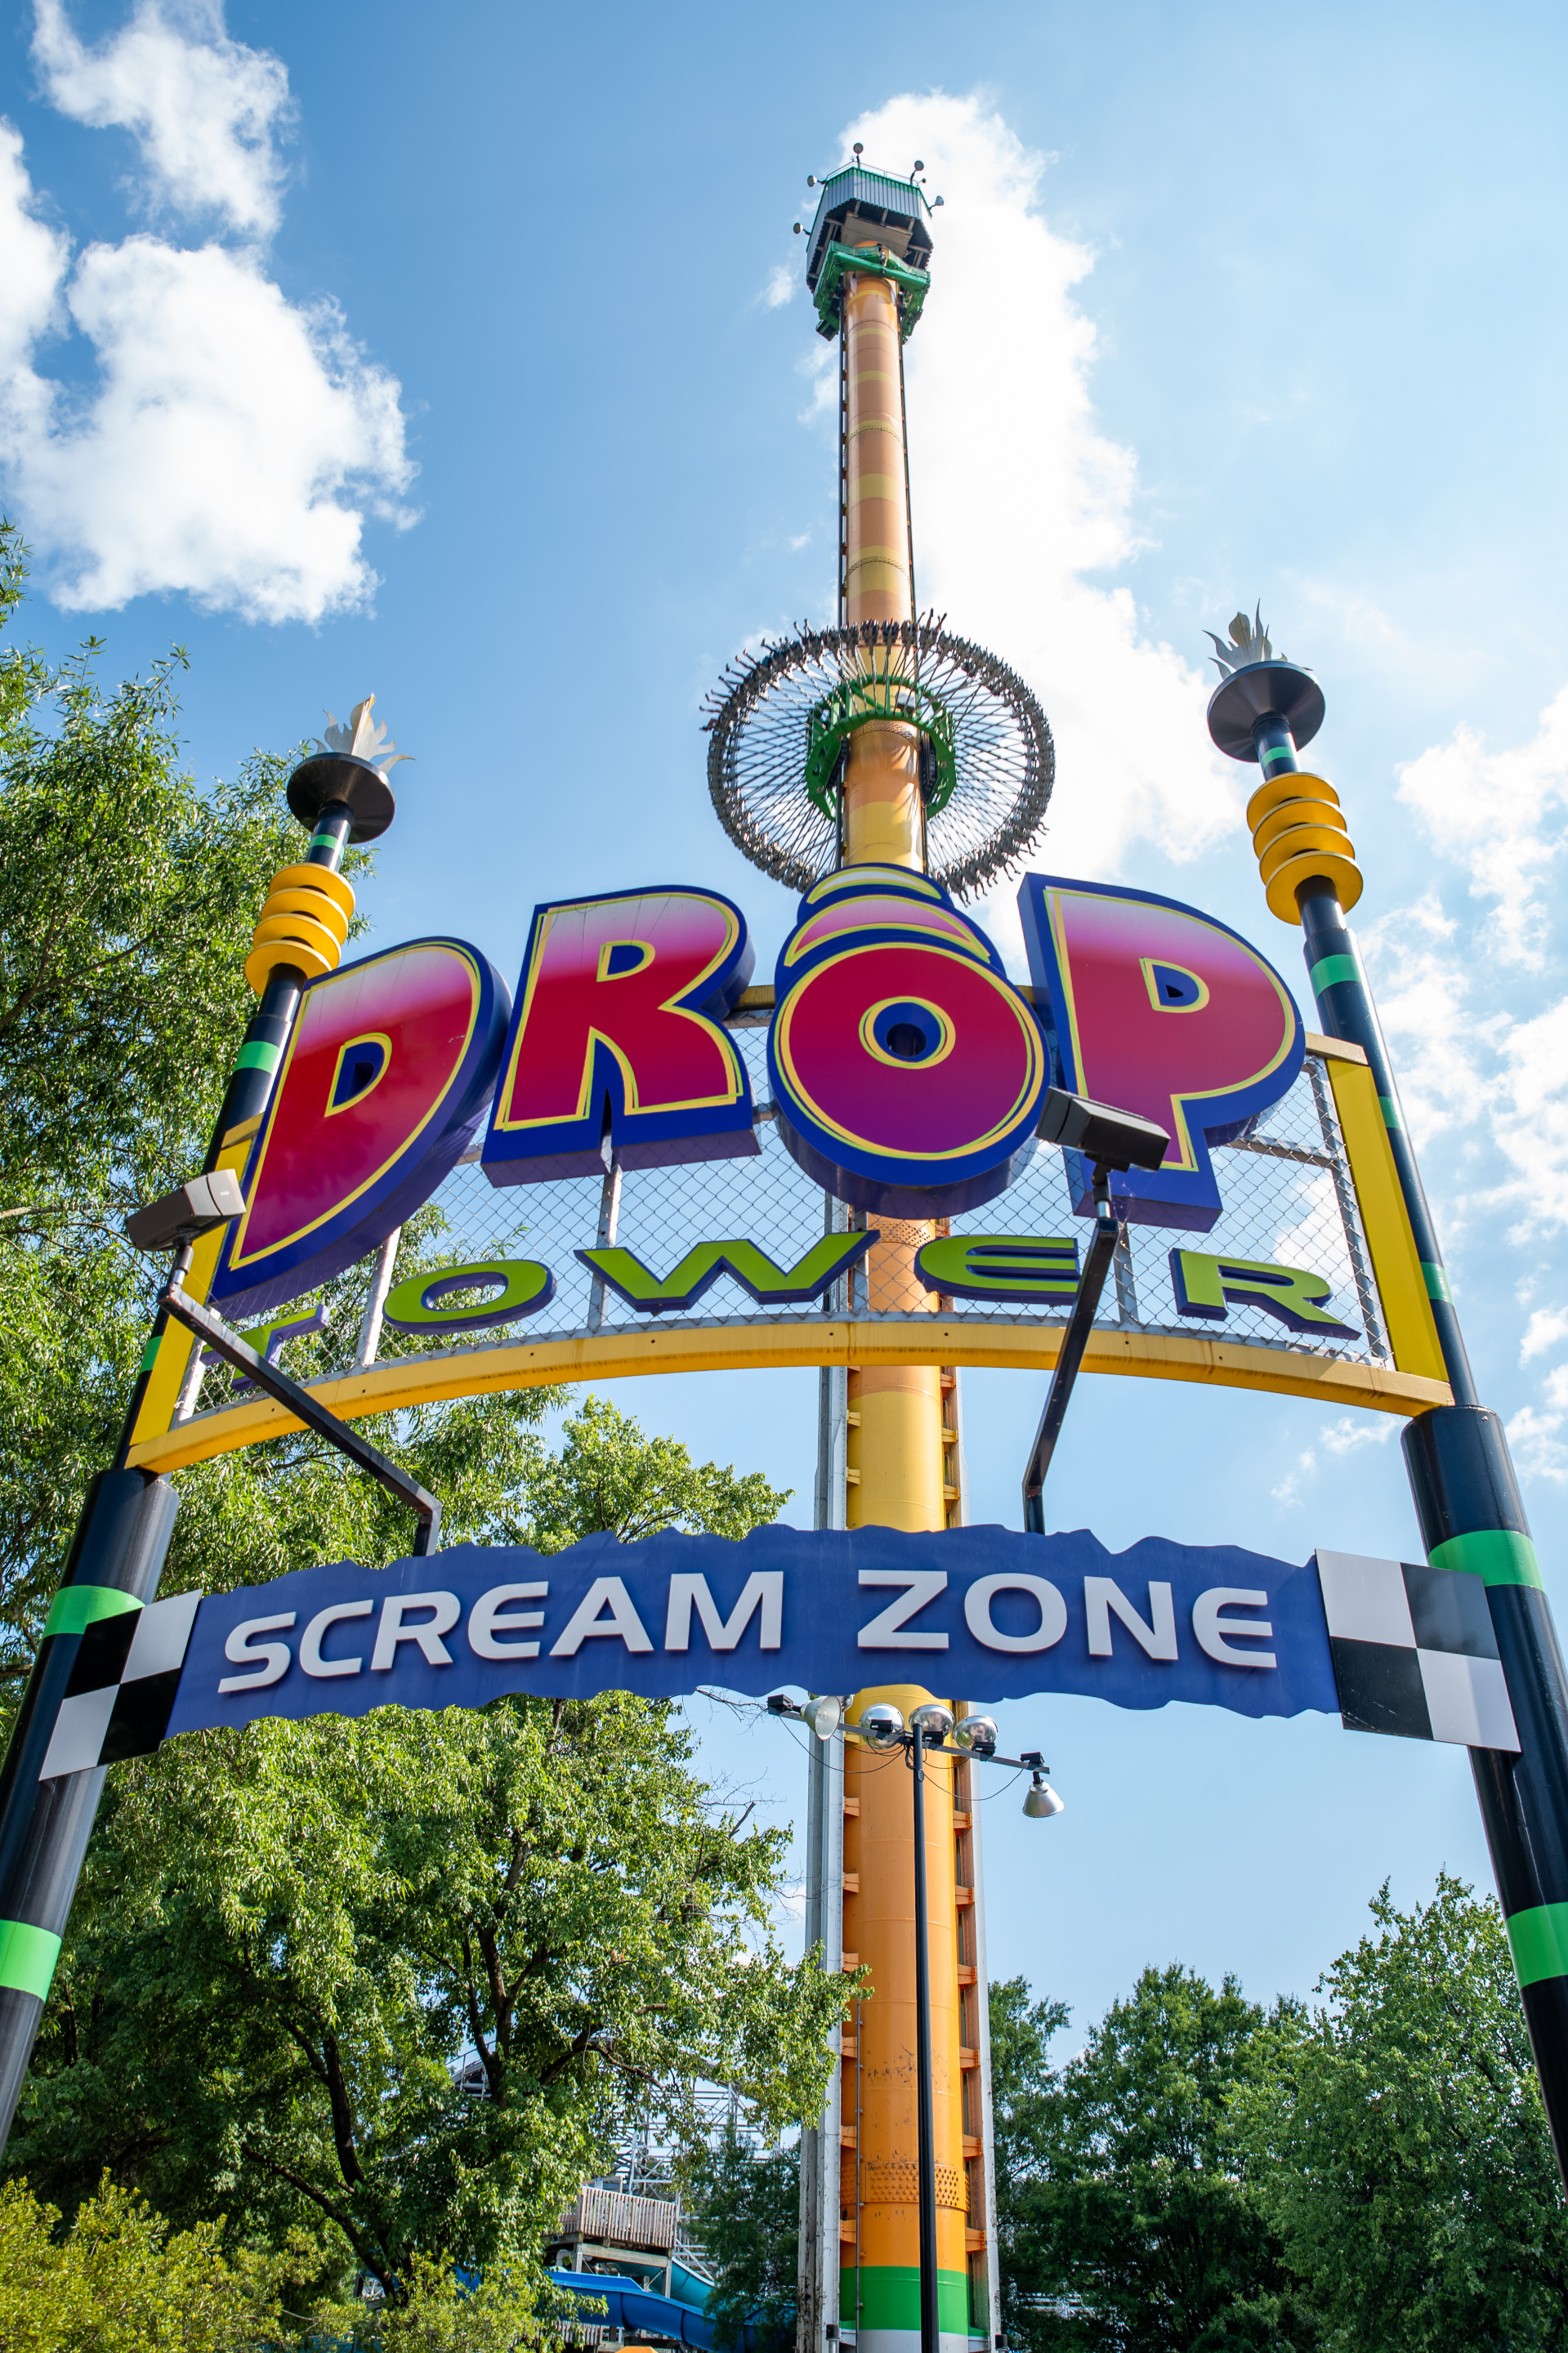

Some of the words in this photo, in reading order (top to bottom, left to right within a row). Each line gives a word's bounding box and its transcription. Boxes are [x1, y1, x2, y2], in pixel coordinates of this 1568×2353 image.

[210, 863, 1305, 1312] DROP
[201, 1229, 1360, 1391] TOWER
[217, 1570, 785, 1694] SCREAM
[857, 1569, 1278, 1669] ZONE
